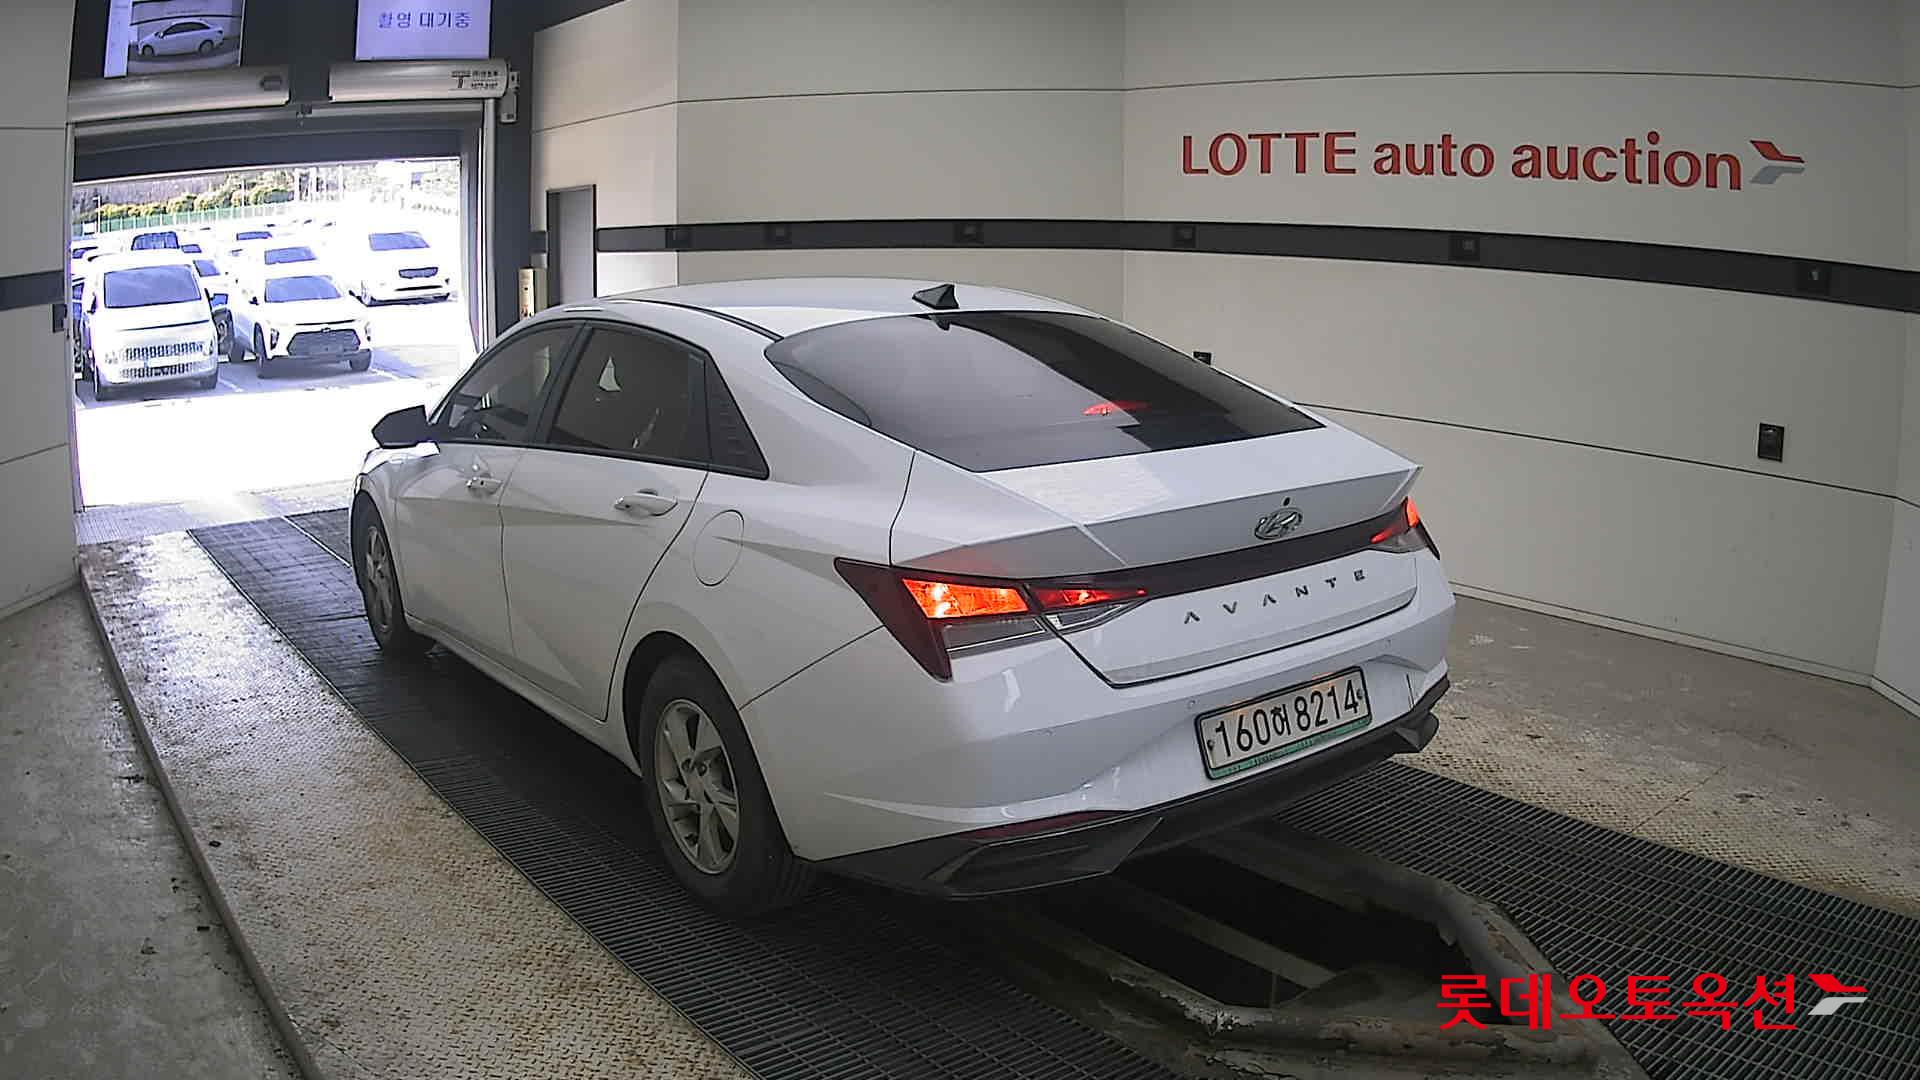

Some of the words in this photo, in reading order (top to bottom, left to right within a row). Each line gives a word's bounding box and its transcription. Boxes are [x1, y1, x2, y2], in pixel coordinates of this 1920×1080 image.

[419, 11, 472, 29] 대기중
[1183, 132, 1356, 175] LOTTE
[1374, 134, 1495, 177] auto
[1511, 131, 1742, 190] auction
[1184, 570, 1366, 625] AVANTE
